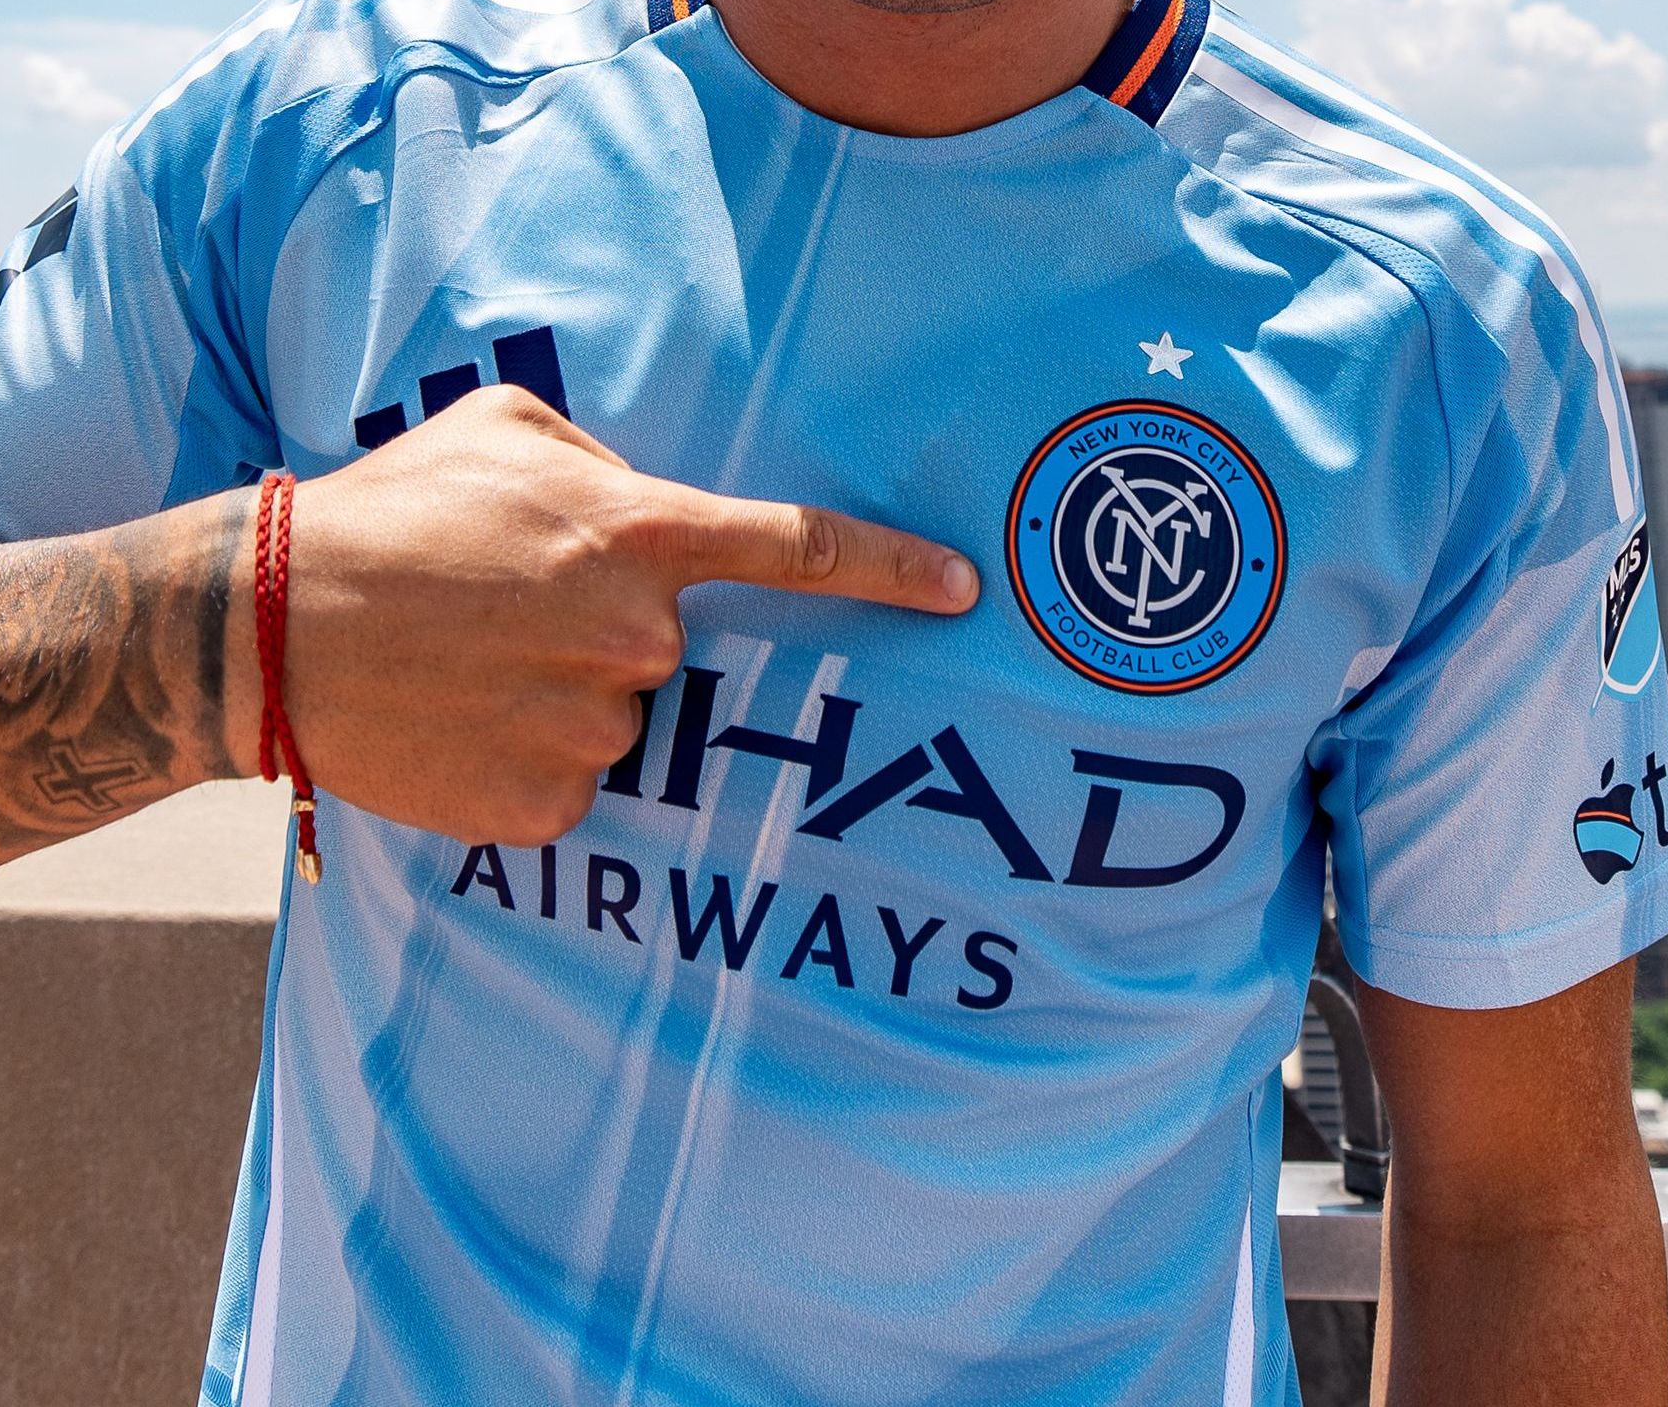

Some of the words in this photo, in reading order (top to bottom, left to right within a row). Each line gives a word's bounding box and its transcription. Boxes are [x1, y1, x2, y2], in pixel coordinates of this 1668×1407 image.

[1067, 423, 1120, 460] NEW
[1128, 421, 1193, 449] YORK
[1197, 442, 1244, 486] CITY
[1609, 537, 1642, 601] MLS
[1046, 601, 1164, 673] FOOTBALL
[1172, 629, 1229, 671] CLUB
[449, 842, 1020, 1011] AIRWAYS
